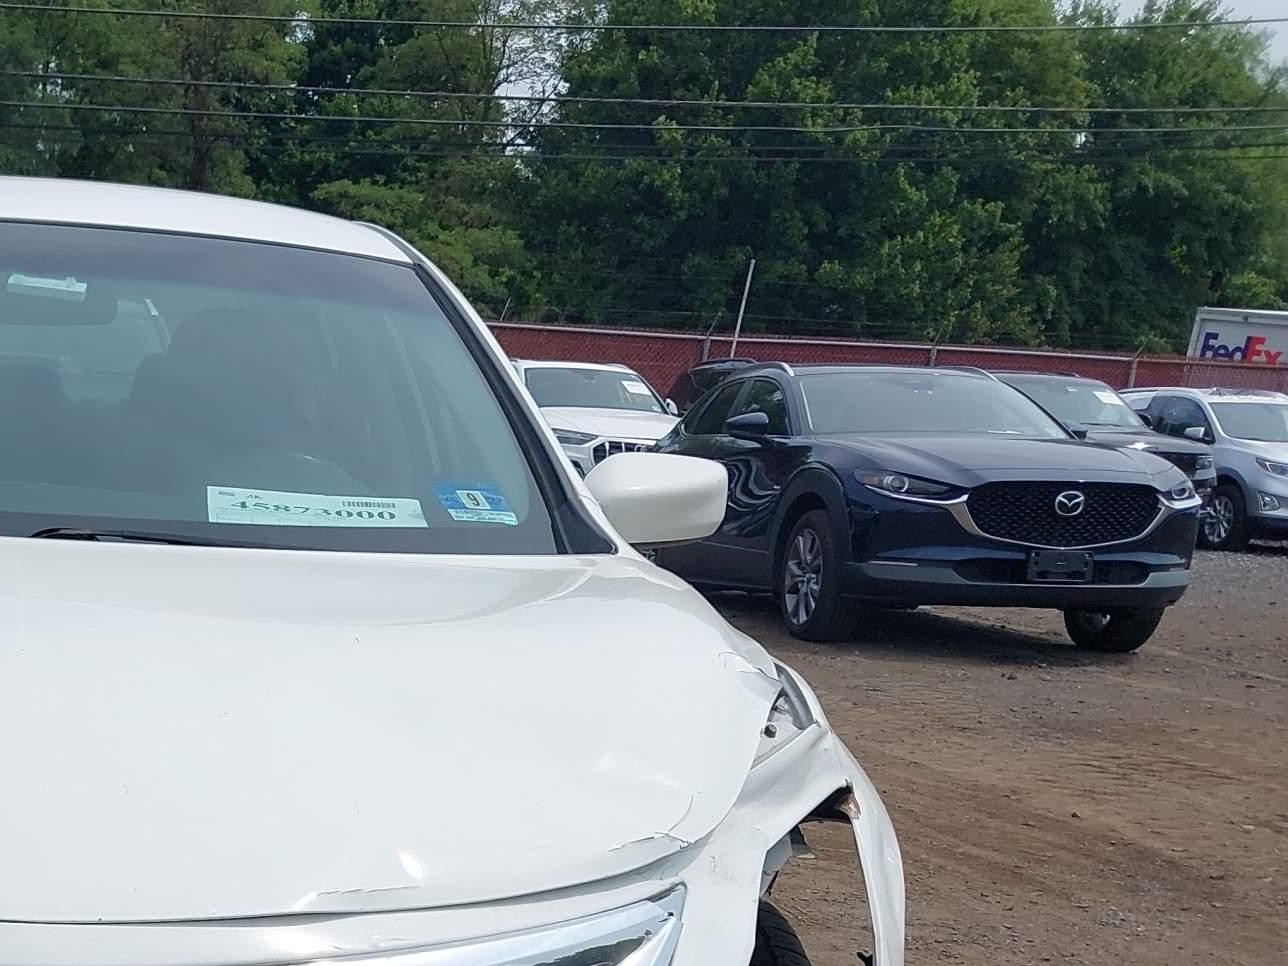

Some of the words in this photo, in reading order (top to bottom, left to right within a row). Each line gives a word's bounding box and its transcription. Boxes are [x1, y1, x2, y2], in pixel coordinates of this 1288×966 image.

[1200, 332, 1283, 365] FedEx
[466, 492, 481, 507] 9
[231, 501, 396, 520] 45873000
